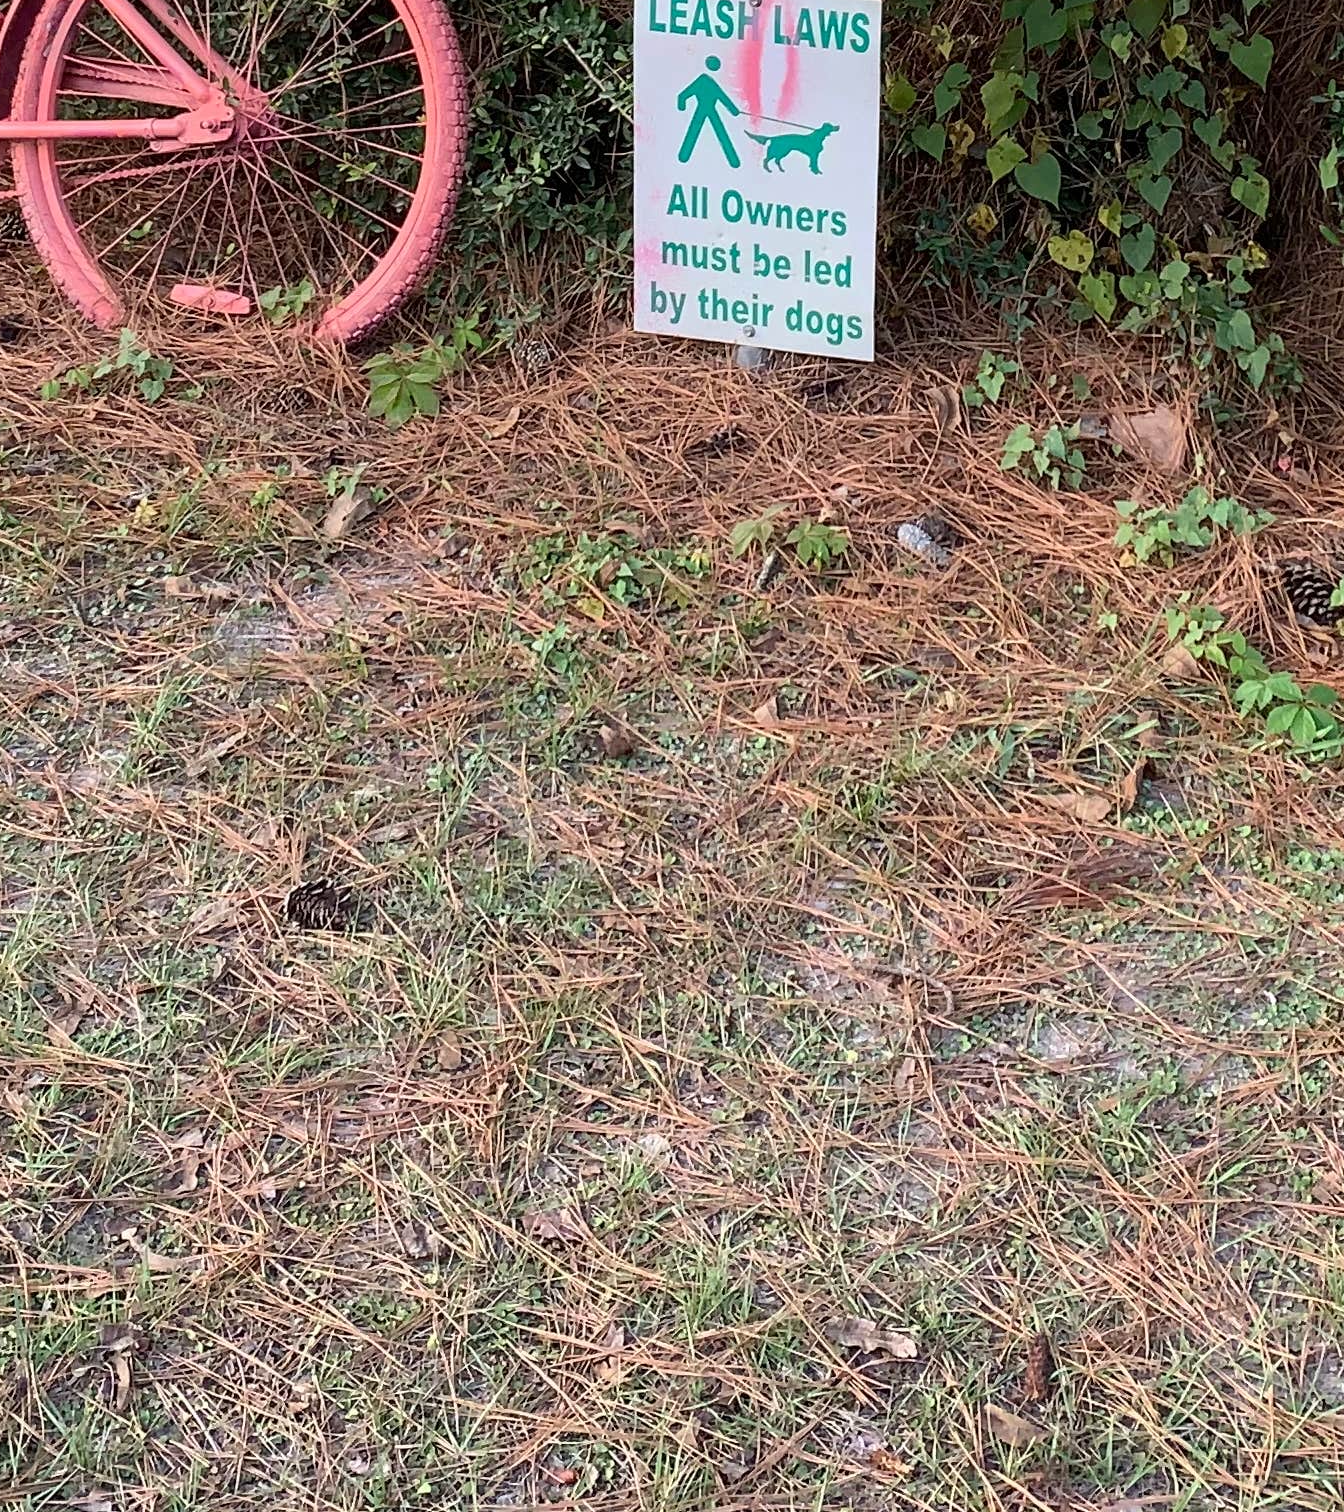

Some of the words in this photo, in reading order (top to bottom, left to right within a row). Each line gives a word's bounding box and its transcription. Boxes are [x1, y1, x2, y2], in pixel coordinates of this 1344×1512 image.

[774, 8, 870, 53] LAWS
[667, 184, 708, 219] All
[721, 190, 846, 236] Owners
[662, 242, 740, 273] must
[754, 244, 791, 279] be
[805, 250, 851, 288] led
[651, 286, 686, 324] by
[698, 288, 774, 327] their
[786, 300, 862, 345] dogs
